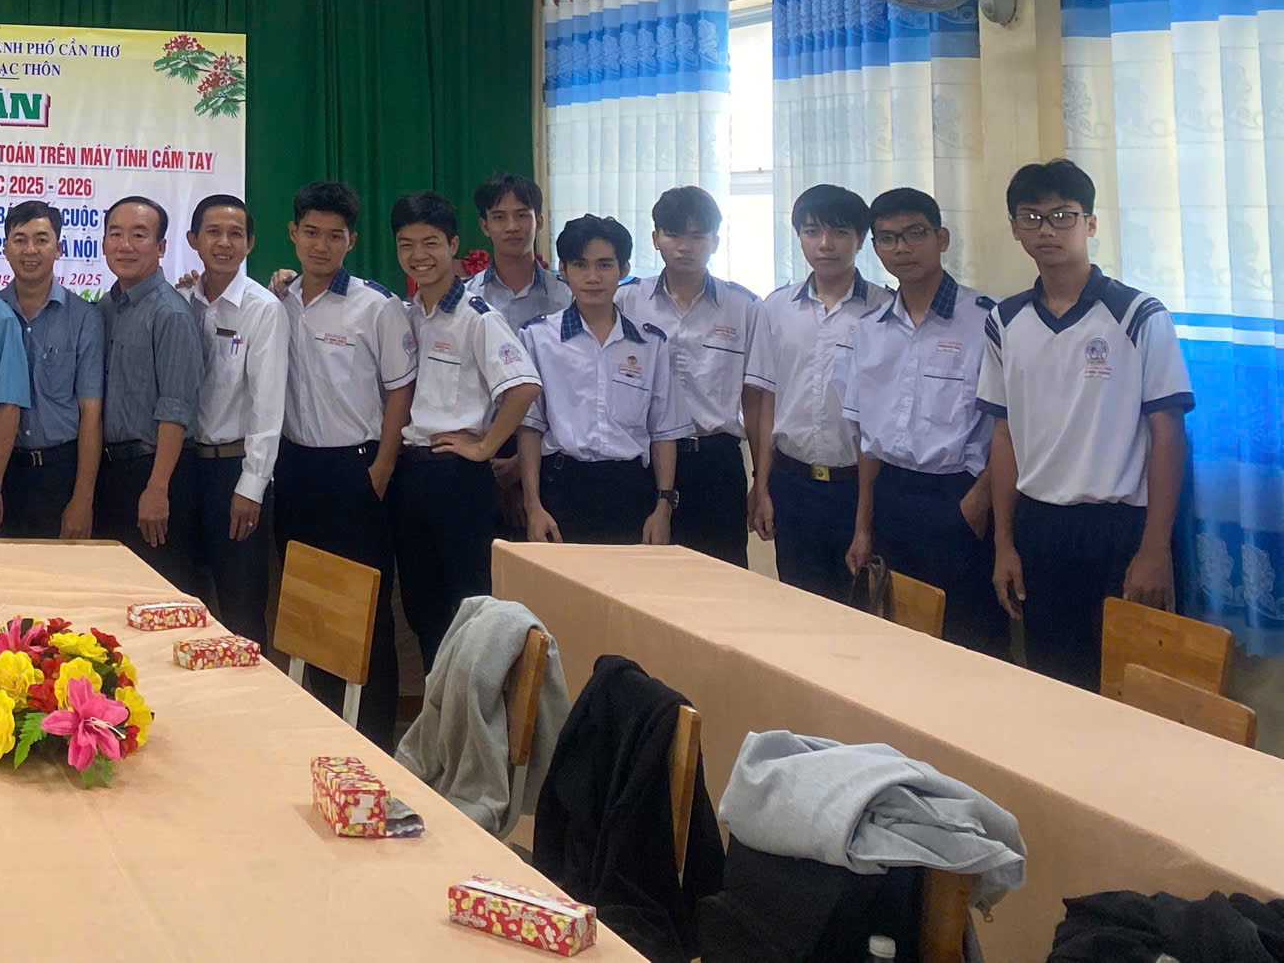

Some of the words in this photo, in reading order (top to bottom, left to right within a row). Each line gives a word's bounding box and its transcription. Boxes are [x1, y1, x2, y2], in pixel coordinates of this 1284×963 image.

[26, 37, 55, 55] PHỐ
[59, 37, 88, 56] CẦN
[91, 44, 121, 58] THƠ
[22, 60, 61, 76] THÔN
[39, 142, 76, 166] TRÊN
[80, 144, 113, 167] MÁY
[115, 144, 148, 168] TÍNH
[152, 144, 184, 170] CẦM
[188, 151, 214, 171] TAY
[9, 176, 44, 196] 2025
[57, 178, 93, 197] 2026
[62, 204, 99, 232] CUỘC
[60, 235, 69, 258] À
[73, 235, 98, 263] NỘI
[69, 272, 103, 286] 2025
